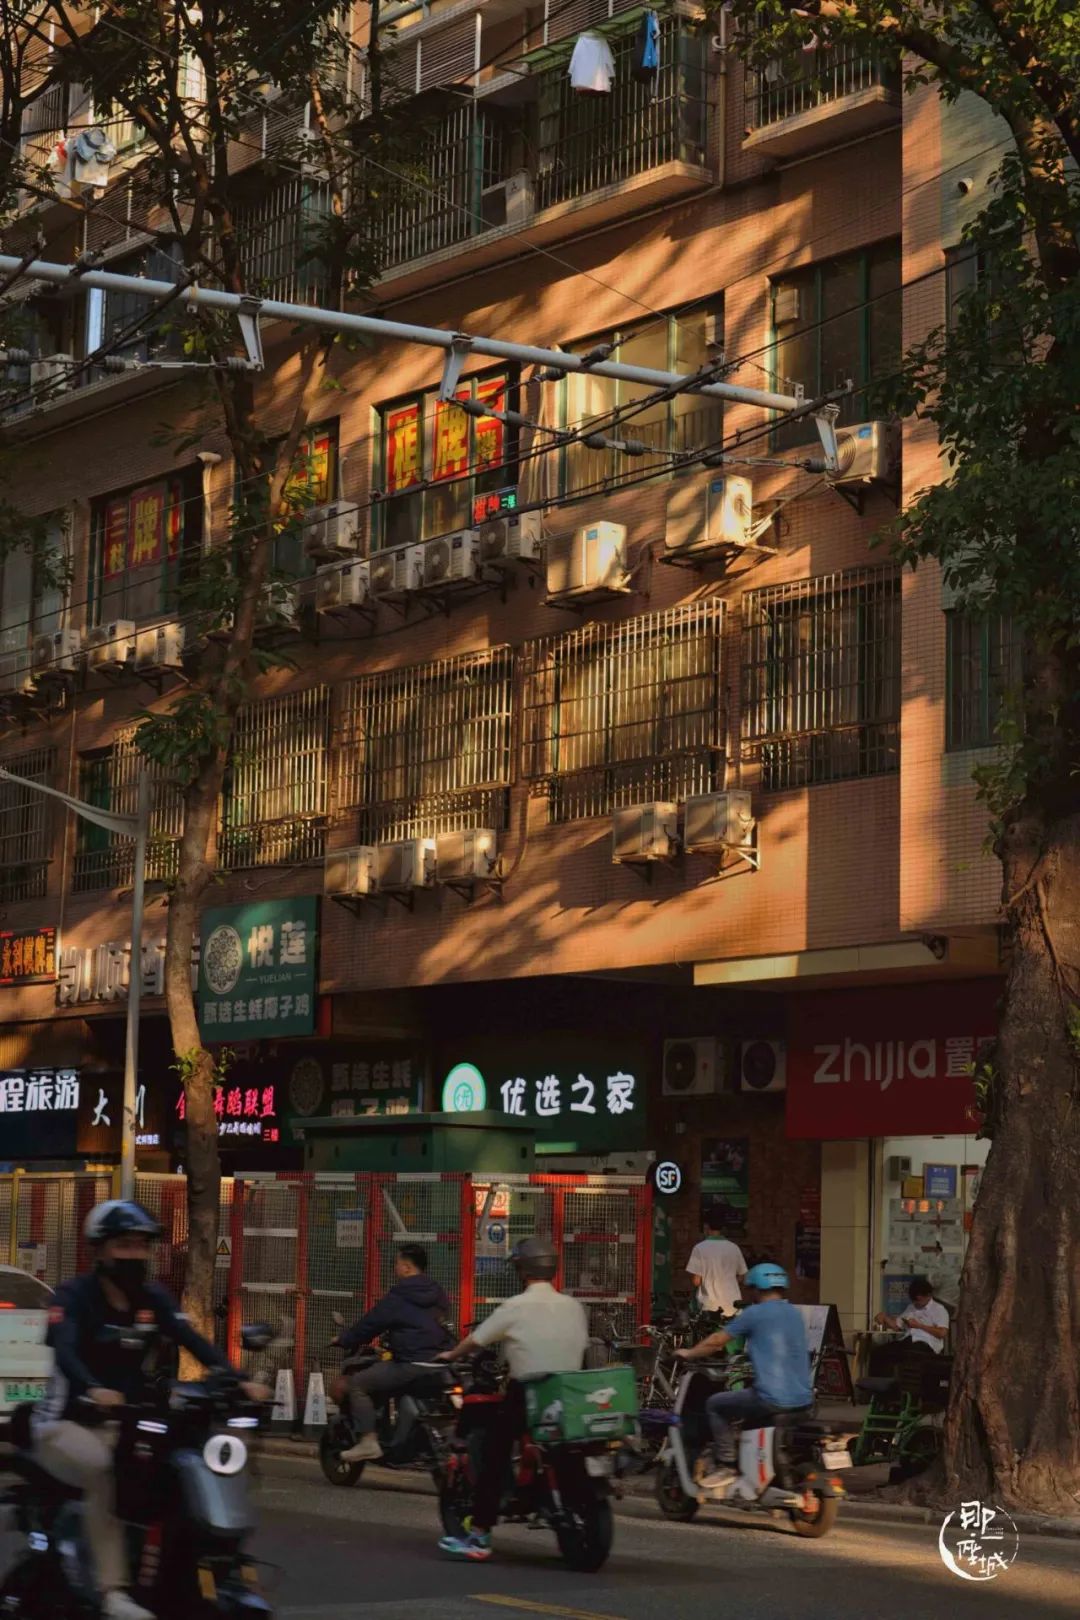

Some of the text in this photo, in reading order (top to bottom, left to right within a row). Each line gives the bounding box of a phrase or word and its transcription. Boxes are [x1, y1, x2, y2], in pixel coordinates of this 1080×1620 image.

[0, 1074, 80, 1113] 程旅游
[499, 1071, 636, 1116] 优选之家
[660, 1171, 679, 1189] SF
